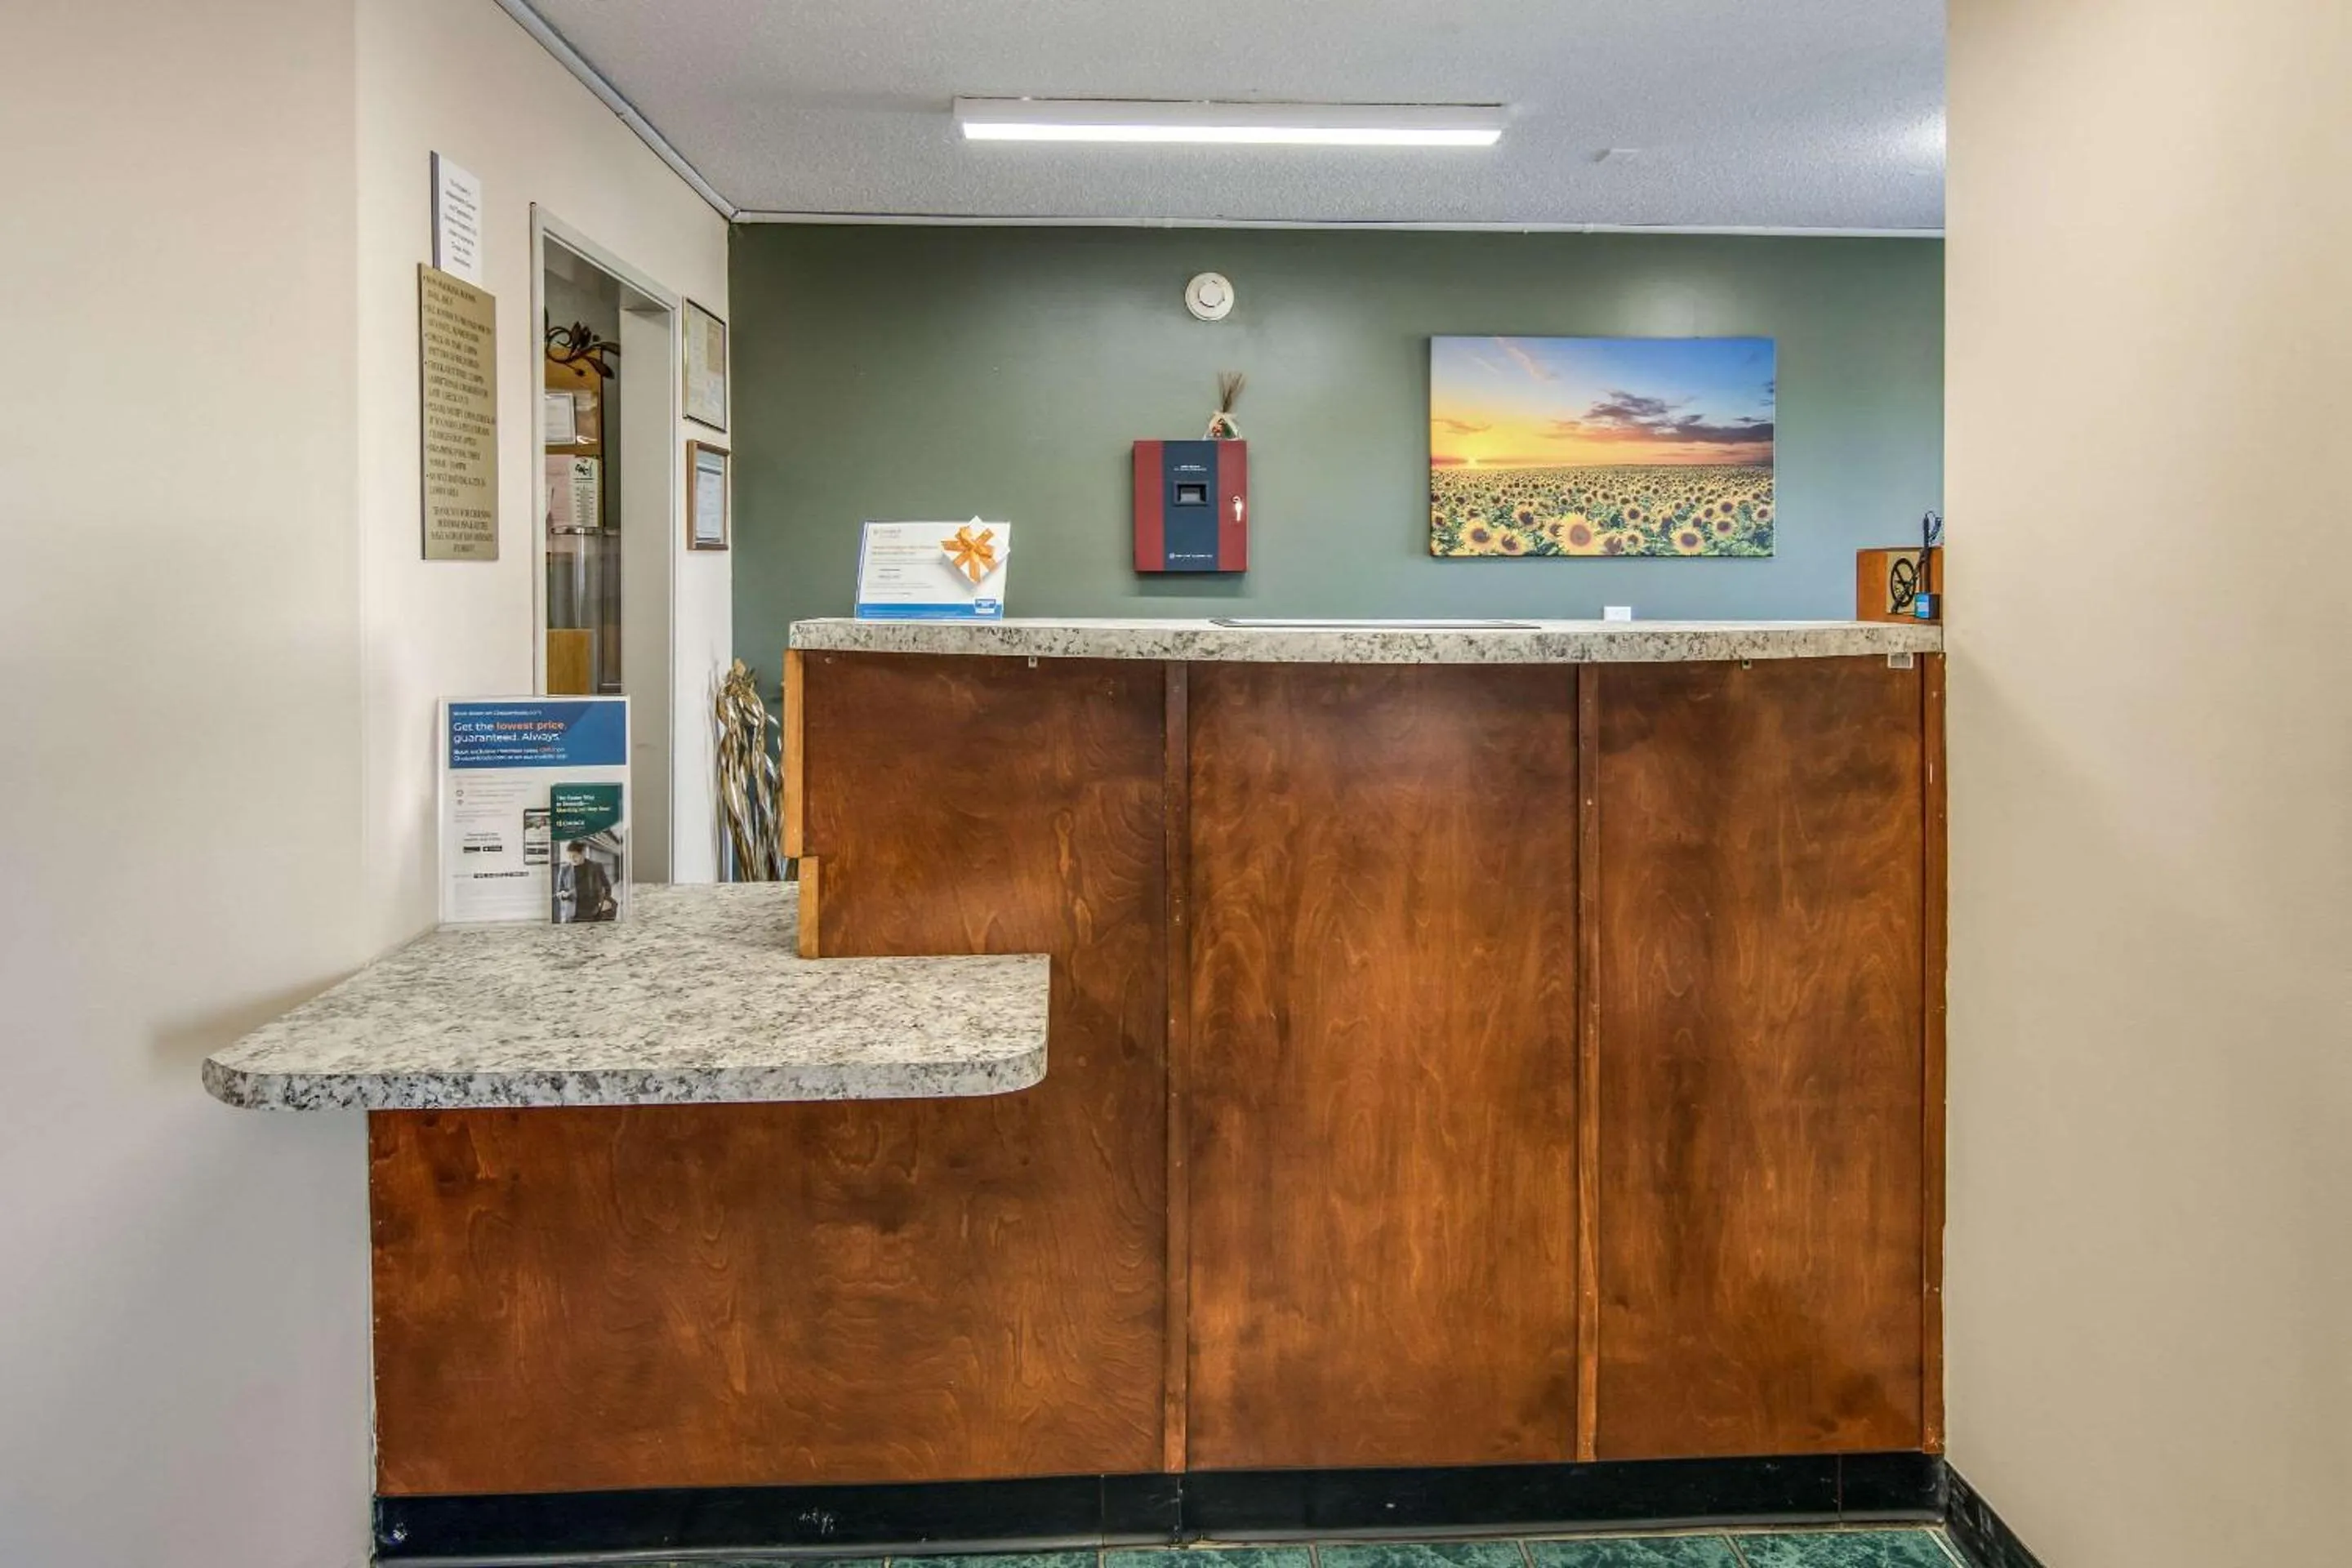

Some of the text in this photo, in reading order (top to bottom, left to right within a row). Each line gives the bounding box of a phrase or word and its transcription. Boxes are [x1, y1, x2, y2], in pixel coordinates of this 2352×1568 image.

[453, 722, 474, 731] Get
[476, 722, 494, 731] the
[497, 721, 534, 730] lowest
[453, 733, 520, 744] guaranteed.
